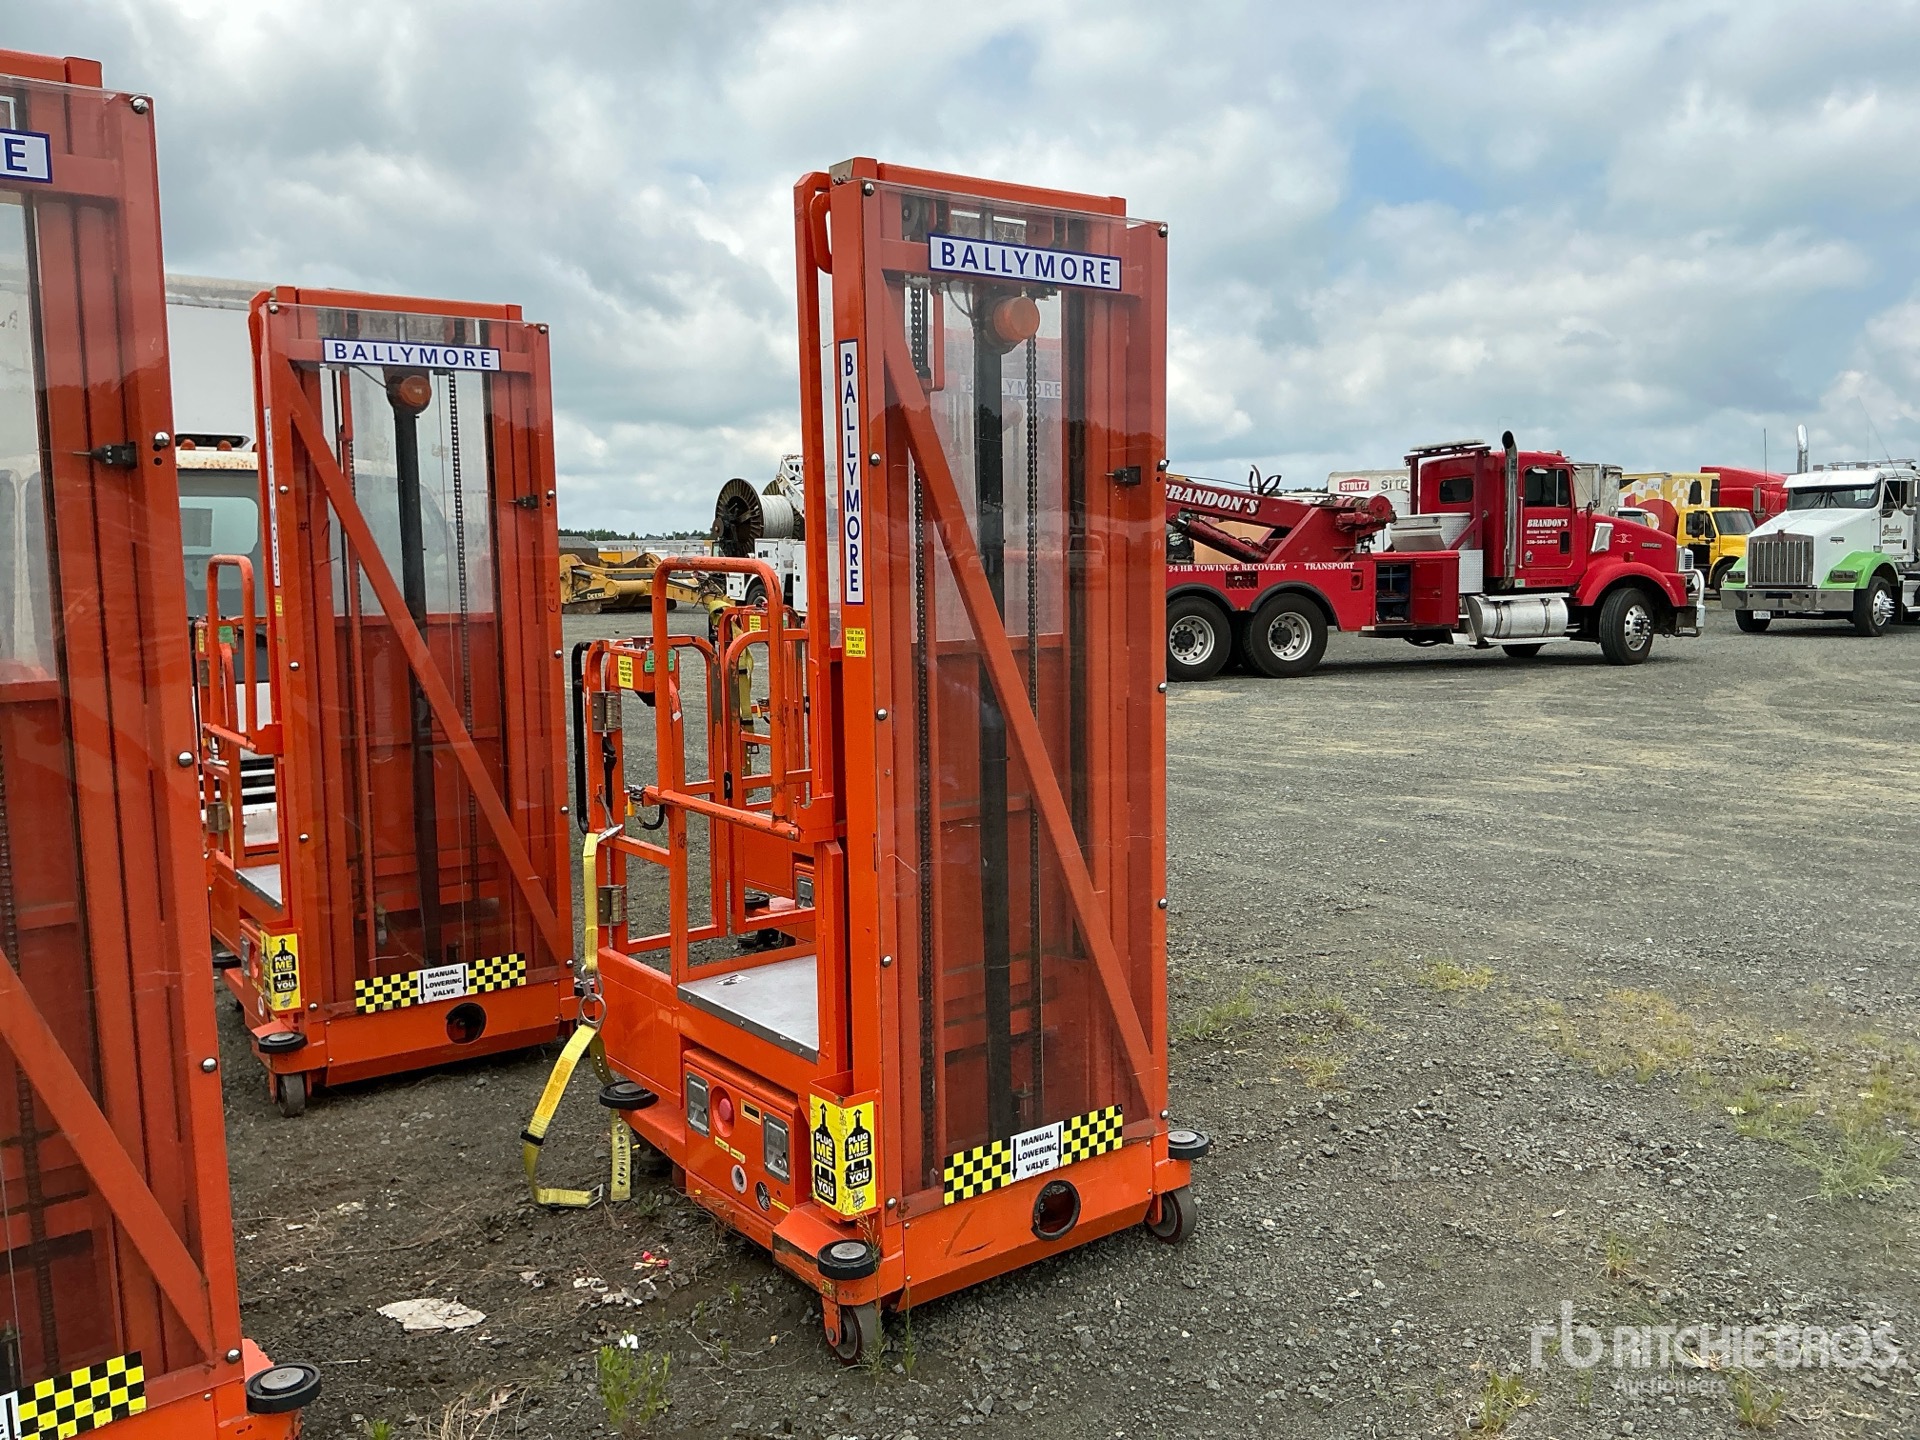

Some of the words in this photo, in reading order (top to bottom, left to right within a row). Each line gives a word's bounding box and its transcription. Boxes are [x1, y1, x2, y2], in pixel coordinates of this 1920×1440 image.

[941, 241, 1111, 285] BALLYMORE
[334, 342, 492, 367] BALLYMORE
[844, 352, 861, 592] BALLYMORE
[1340, 481, 1368, 491] STOLTZ
[1527, 519, 1569, 528] BRANDON'S
[1180, 564, 1193, 572] HR
[1194, 564, 1231, 572] TOWING
[1241, 563, 1287, 571] RECOVERY
[1304, 562, 1355, 571] TRANSPORT
[275, 961, 293, 969] ME
[428, 969, 459, 979] MANUAL
[277, 981, 295, 990] YOU
[425, 978, 462, 989] LOWERING
[433, 988, 455, 997] VALVE
[816, 1132, 833, 1148] PLUG
[848, 1132, 869, 1145] PLUG
[1021, 1131, 1054, 1147] MANUAL
[816, 1140, 833, 1161] ME
[848, 1140, 869, 1155] ME
[1017, 1143, 1057, 1161] LOWERING
[1026, 1158, 1049, 1172] VALVE
[849, 1170, 869, 1183] YOU
[817, 1180, 834, 1197] YOU
